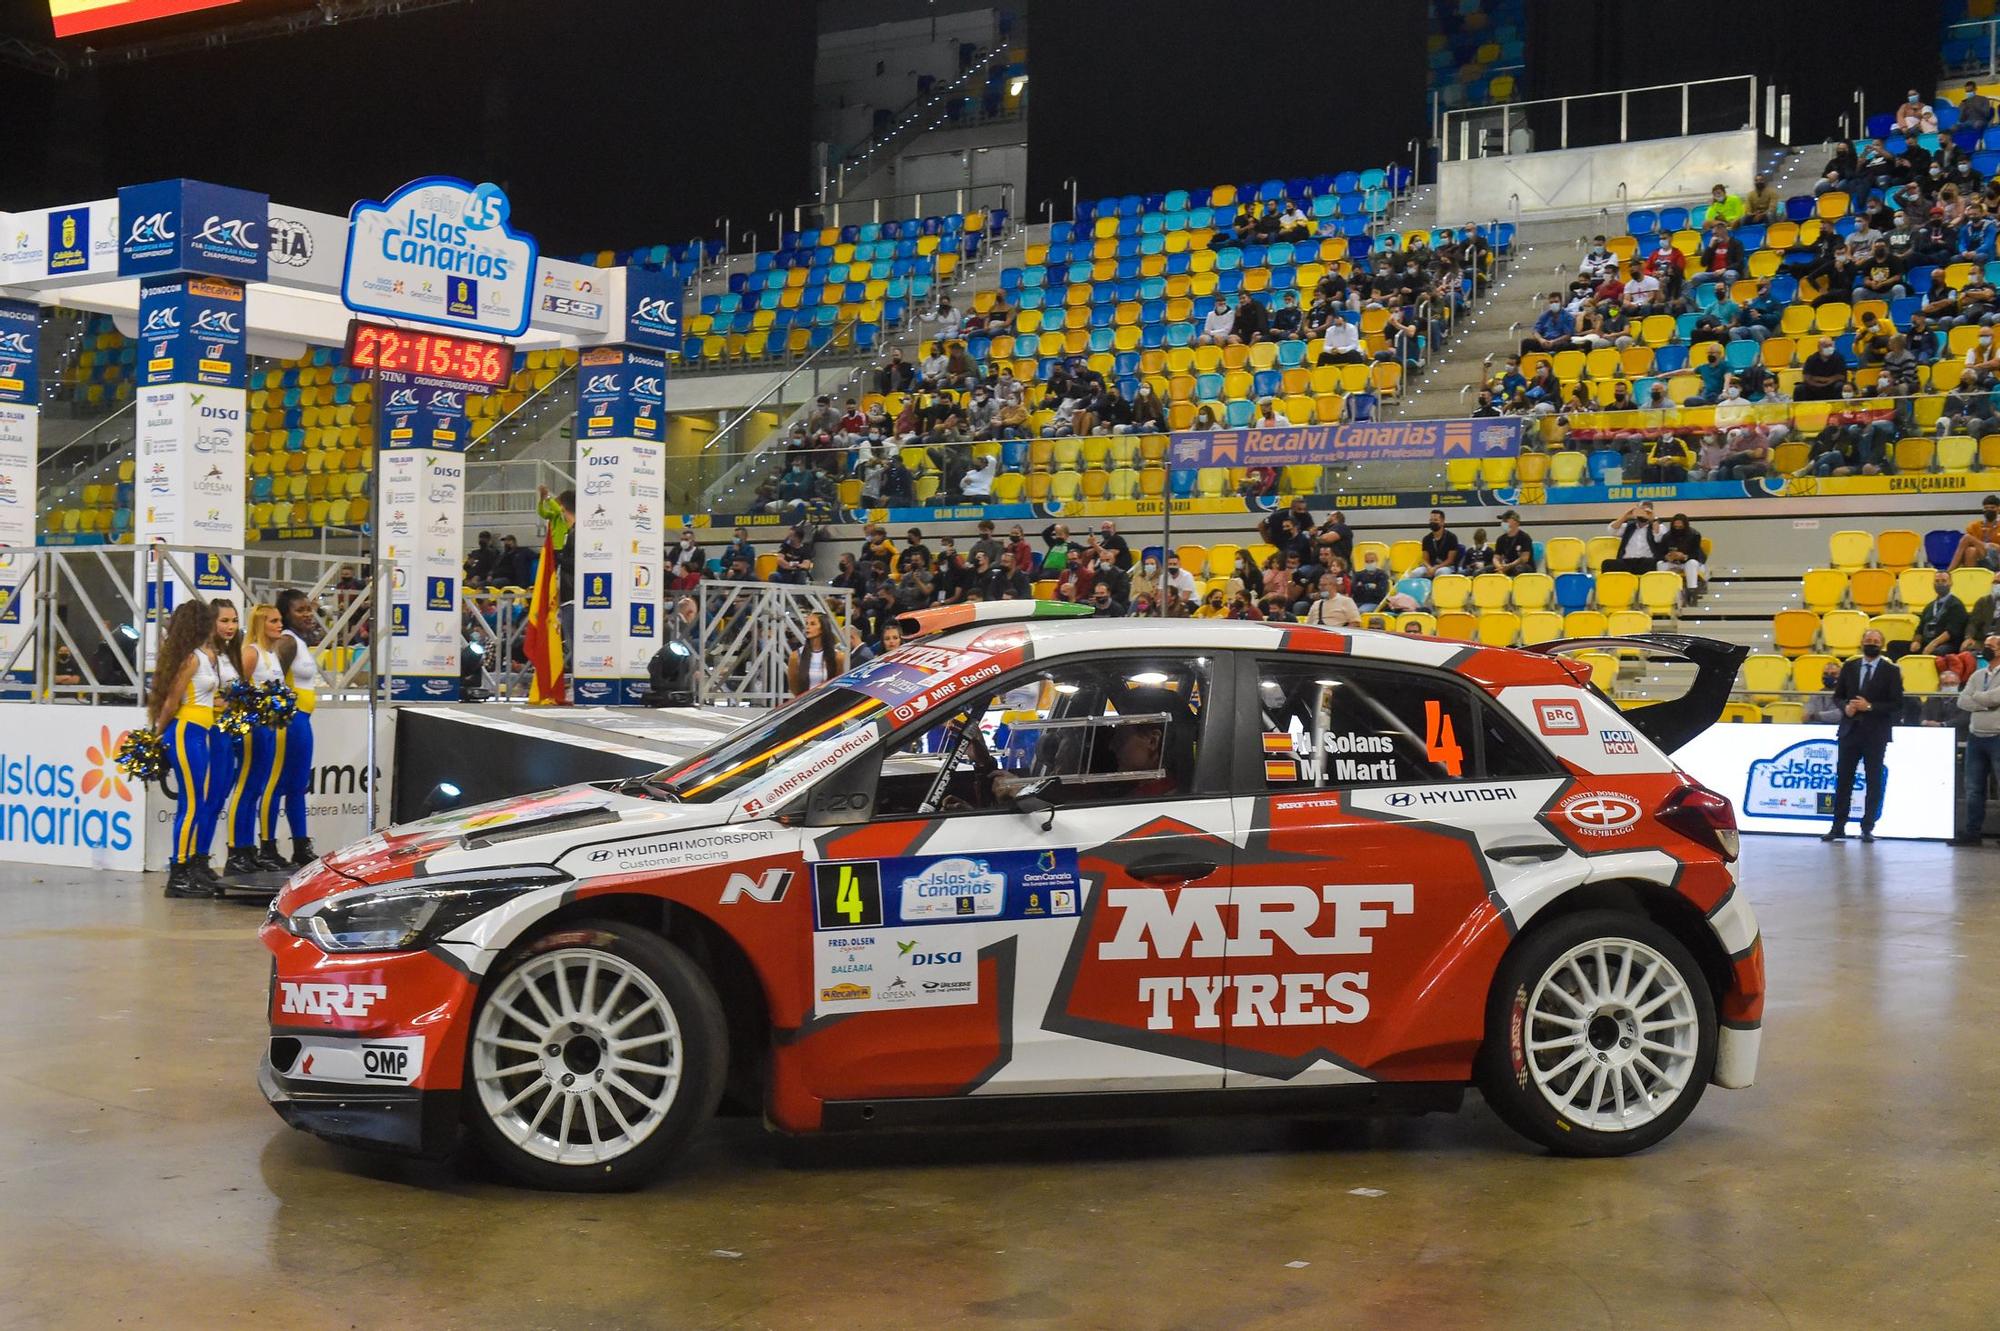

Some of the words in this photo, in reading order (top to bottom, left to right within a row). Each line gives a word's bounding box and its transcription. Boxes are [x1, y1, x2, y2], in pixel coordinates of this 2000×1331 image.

[465, 192, 502, 228] 45
[125, 211, 175, 245] ERC
[193, 216, 259, 249] ERC
[407, 209, 467, 247] Islas
[382, 228, 508, 281] Canarias
[142, 306, 181, 331] ERC
[190, 309, 240, 333] ERC
[632, 297, 677, 324] ERC
[353, 328, 501, 382] 22:15:56
[583, 374, 620, 394] ERC
[629, 376, 662, 396] ERC
[386, 388, 420, 407] ERC
[426, 390, 463, 409] ERC
[1244, 428, 1330, 453] Recalvi
[1334, 422, 1438, 448] Canarias
[1890, 478, 1916, 490] GRAN
[1920, 476, 1967, 490] CANARIA
[1546, 709, 1574, 721] BRC
[1323, 731, 1394, 754] Solans
[1424, 700, 1464, 777] 4
[1601, 731, 1633, 742] LIQUI
[1605, 742, 1637, 754] MOLY
[0, 754, 75, 799] Islas
[766, 730, 874, 804] @MRFRacingOfficial
[1300, 760, 1329, 780] M.
[1336, 759, 1397, 780] Martí
[1788, 758, 1833, 775] Islas
[1420, 788, 1517, 806] HYUNDAI
[1596, 790, 1640, 805] DOMENICO
[1577, 824, 1636, 837] ASSEMBLAGGI
[617, 841, 684, 858] HYUNDAI
[685, 831, 774, 850] MOTORSPORT
[619, 856, 681, 870] Customer
[685, 850, 729, 862] Racing
[918, 880, 992, 898] Canarias
[931, 872, 966, 886] Islas
[836, 866, 864, 924] 4
[1098, 884, 1414, 960] MRF
[828, 938, 850, 948] FRED.
[850, 937, 876, 946] OLSEN
[831, 964, 873, 974] BALEARIA
[848, 954, 856, 962] &
[280, 982, 388, 1017] MRF
[877, 990, 917, 1000] LOPESAN
[1138, 971, 1370, 1030] TYRES
[363, 1050, 408, 1074] OMP
